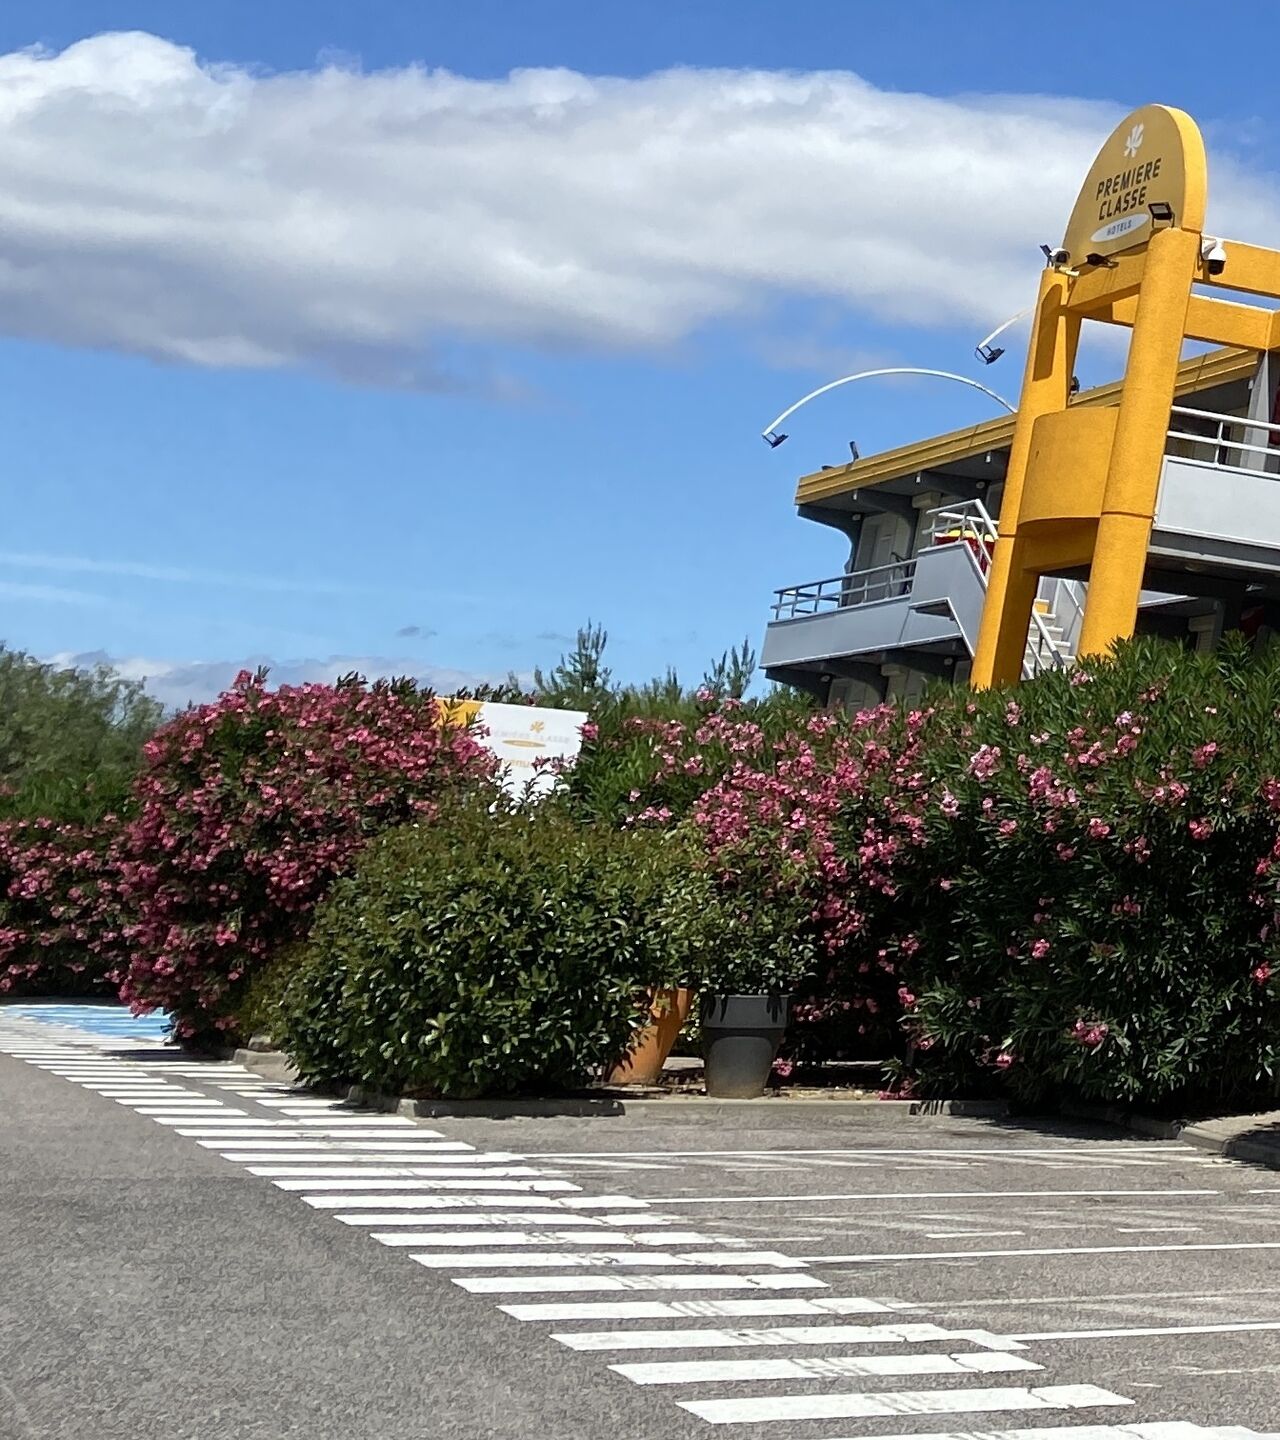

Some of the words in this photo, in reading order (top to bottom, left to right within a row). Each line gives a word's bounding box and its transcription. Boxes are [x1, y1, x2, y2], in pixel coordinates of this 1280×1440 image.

[1095, 157, 1161, 201] PREMIERE
[1098, 186, 1147, 221] CLASSE
[1106, 220, 1132, 236] HOTELS
